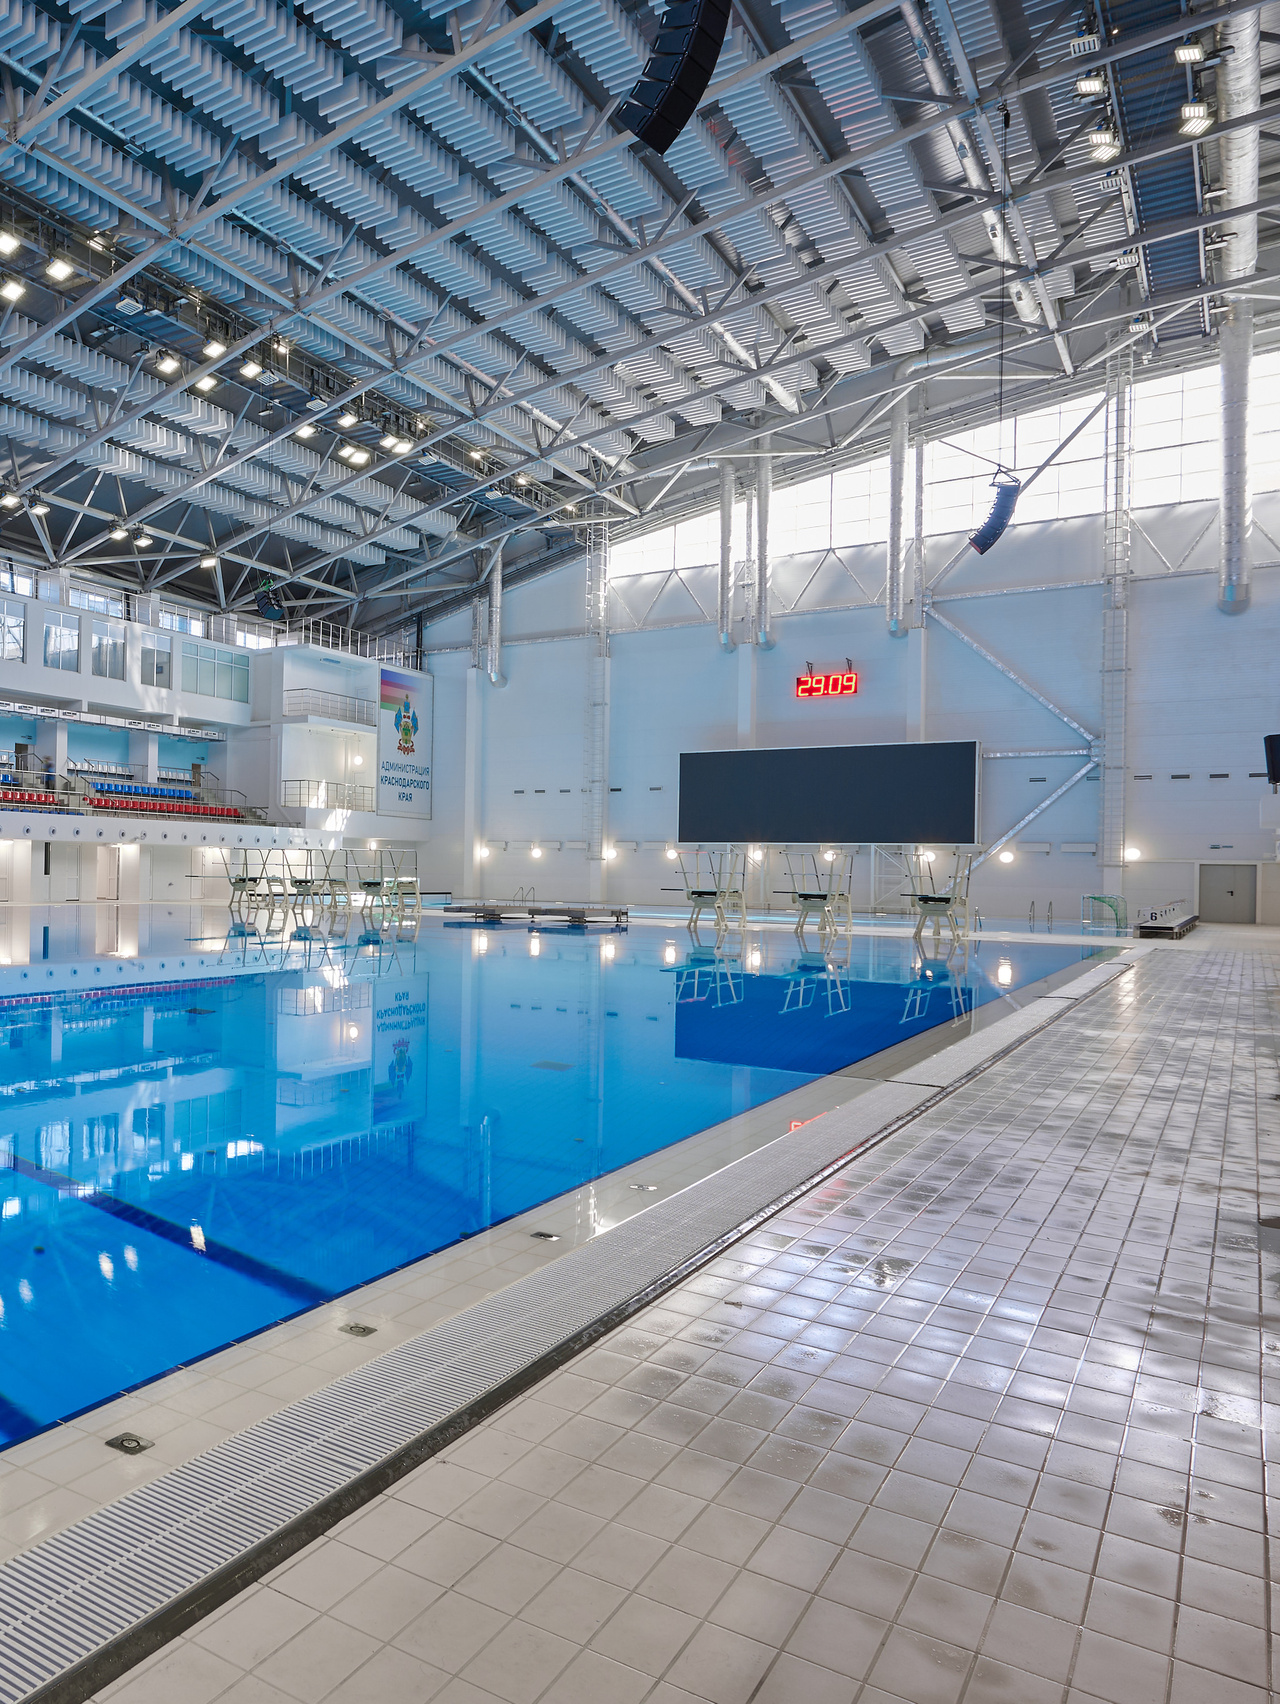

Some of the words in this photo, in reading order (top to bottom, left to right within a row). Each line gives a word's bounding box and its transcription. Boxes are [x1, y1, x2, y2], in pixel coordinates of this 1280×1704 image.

[798, 674, 856, 696] 29.09
[381, 761, 429, 776] АДМИНИСТРАЦИЯ
[380, 775, 429, 790] КРАСНОДАРСКОГО
[398, 792, 413, 802] КРАЯ
[1150, 912, 1158, 920] 6
